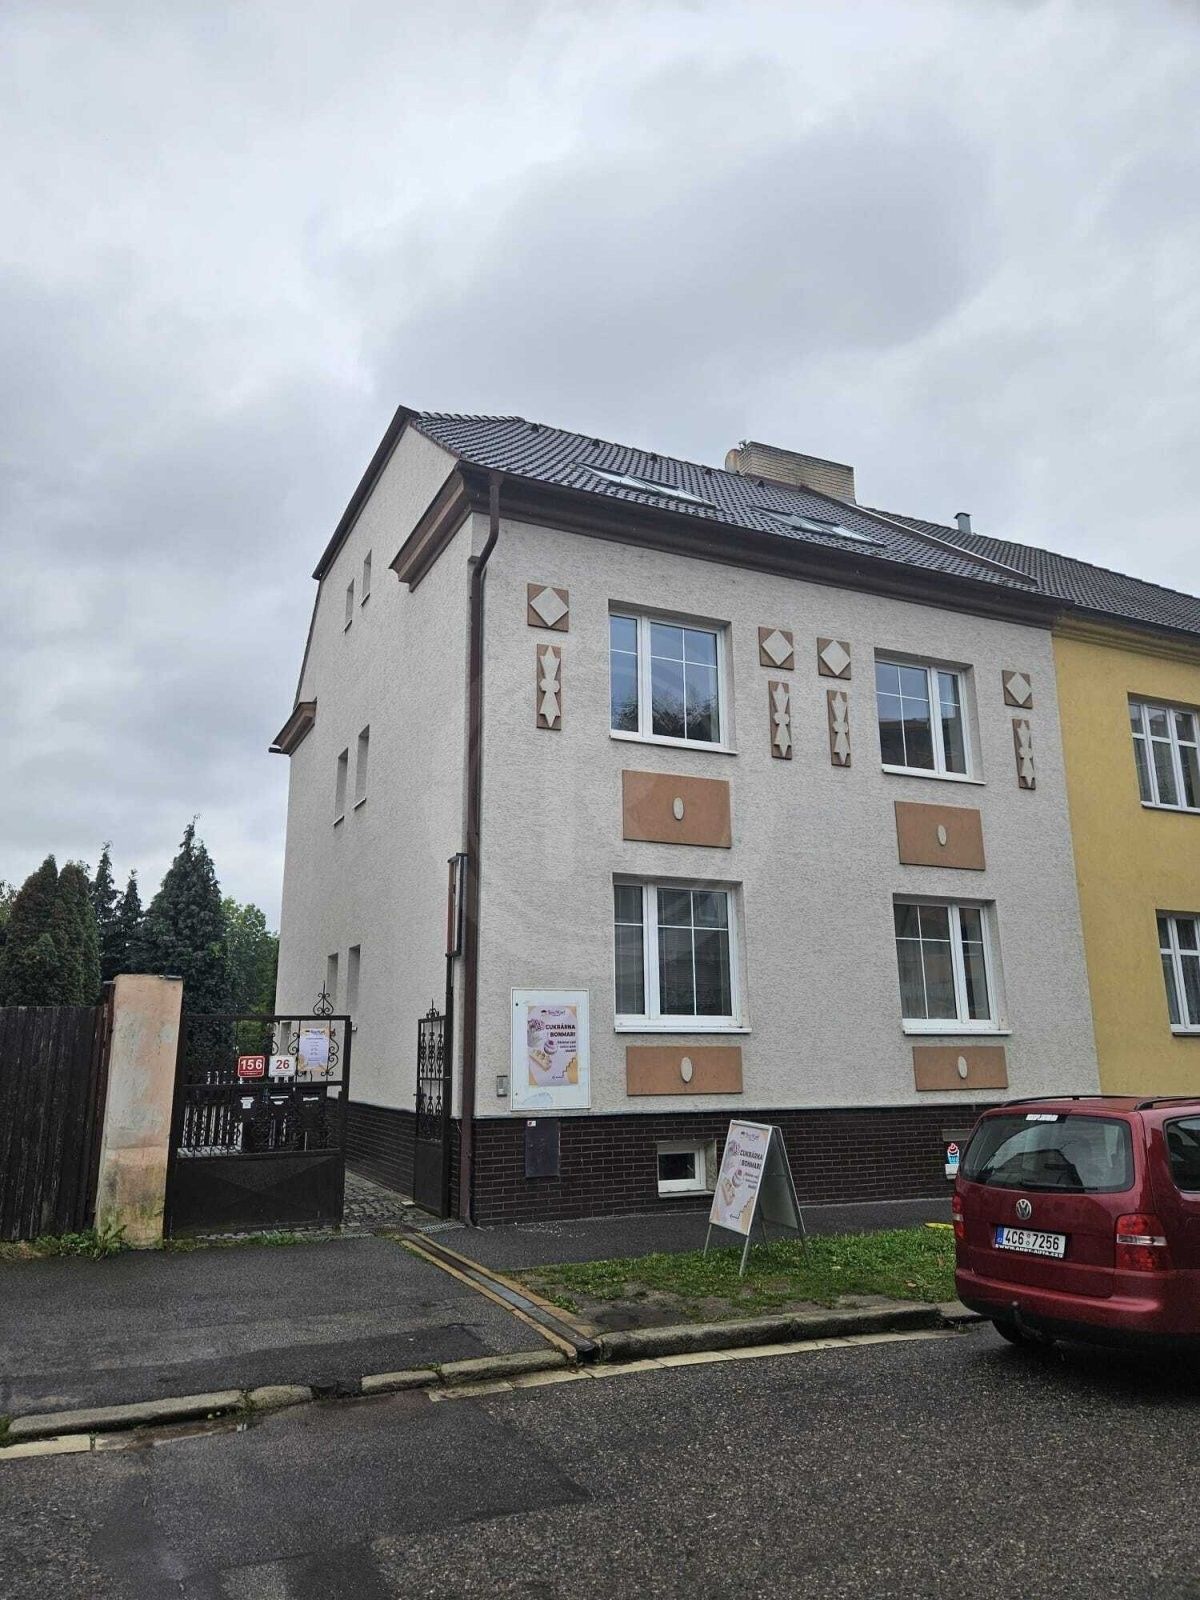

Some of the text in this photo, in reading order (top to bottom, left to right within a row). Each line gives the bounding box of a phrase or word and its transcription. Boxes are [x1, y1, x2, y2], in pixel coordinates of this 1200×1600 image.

[545, 1022, 576, 1030] CUKRÁRNA
[240, 1059, 263, 1070] 156
[276, 1060, 290, 1070] 26
[1005, 1230, 1060, 1250] 4C6 7256
